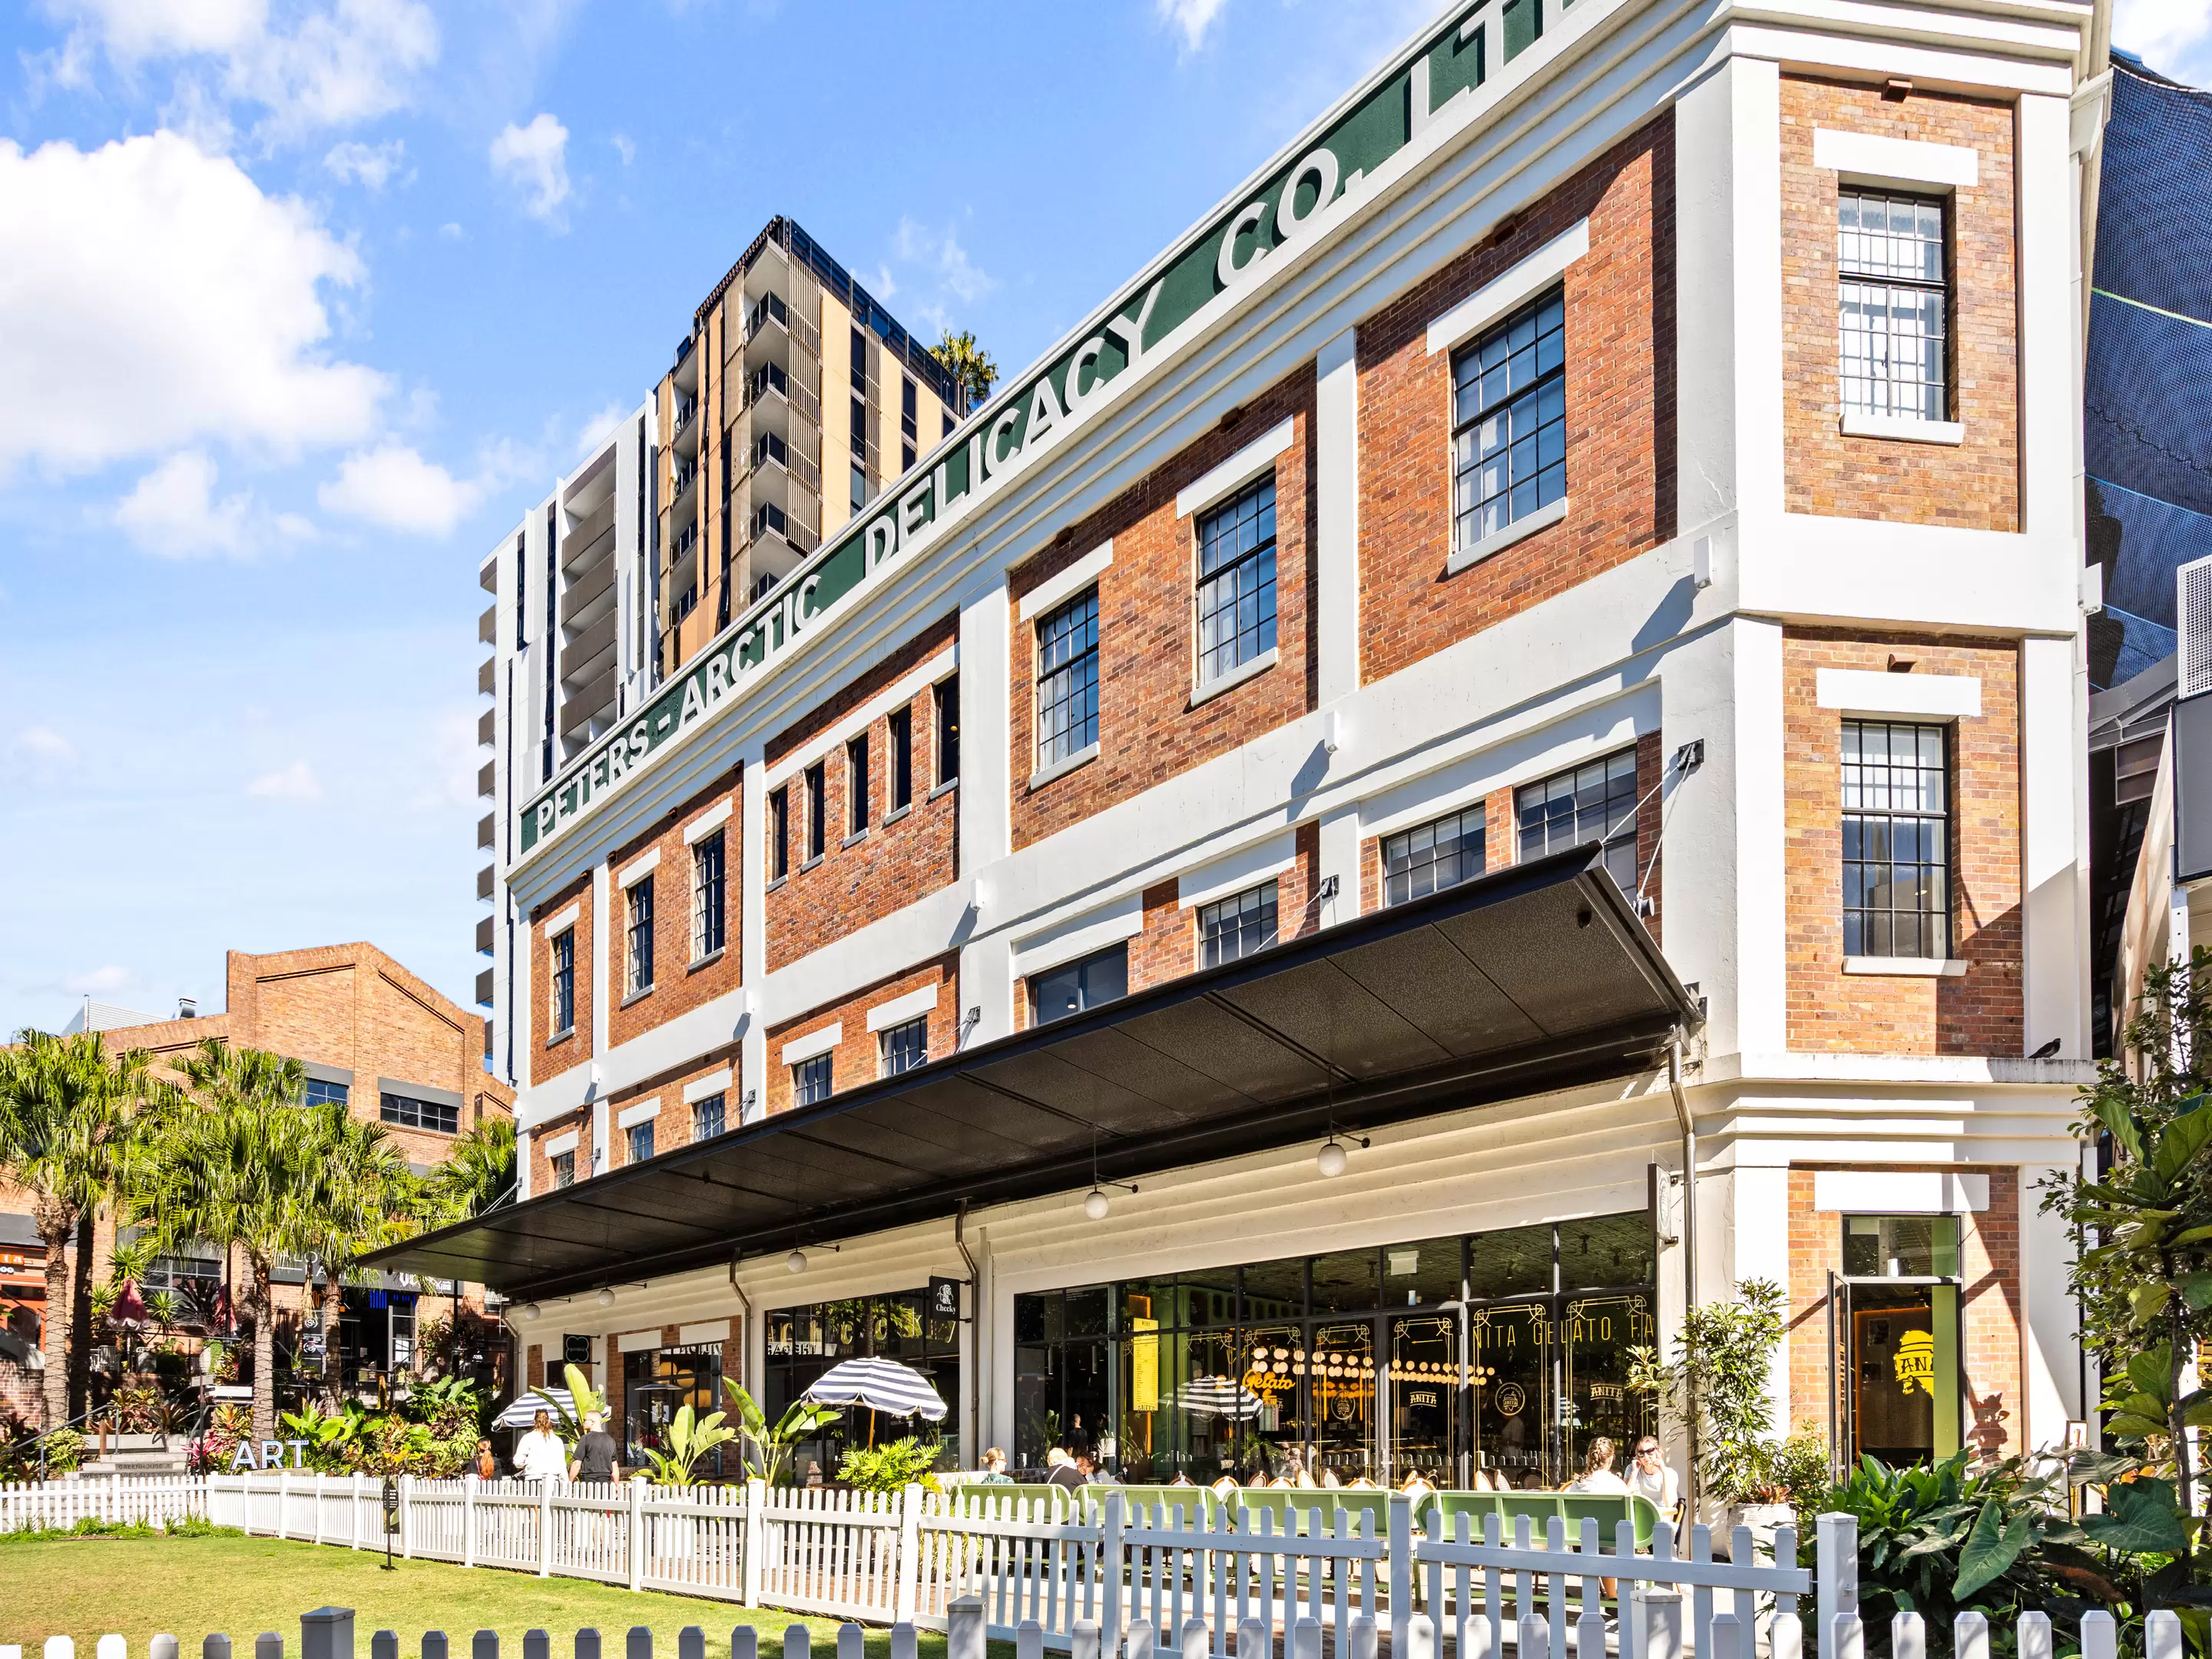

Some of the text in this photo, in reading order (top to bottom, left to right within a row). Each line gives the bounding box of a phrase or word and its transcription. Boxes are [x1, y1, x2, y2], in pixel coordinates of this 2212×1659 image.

[866, 277, 1164, 576] DELICACY
[1217, 148, 1363, 286] CO.
[935, 1303, 956, 1314] Cheeky
[1472, 1325, 1516, 1349] NITA
[1533, 1316, 1611, 1345] GELATO
[1899, 1356, 1934, 1375] AN
[1242, 1368, 1296, 1390] Gelato
[1410, 1393, 1437, 1405] ANITA
[1591, 1386, 1624, 1399] ANITA
[230, 1439, 310, 1470] ART
